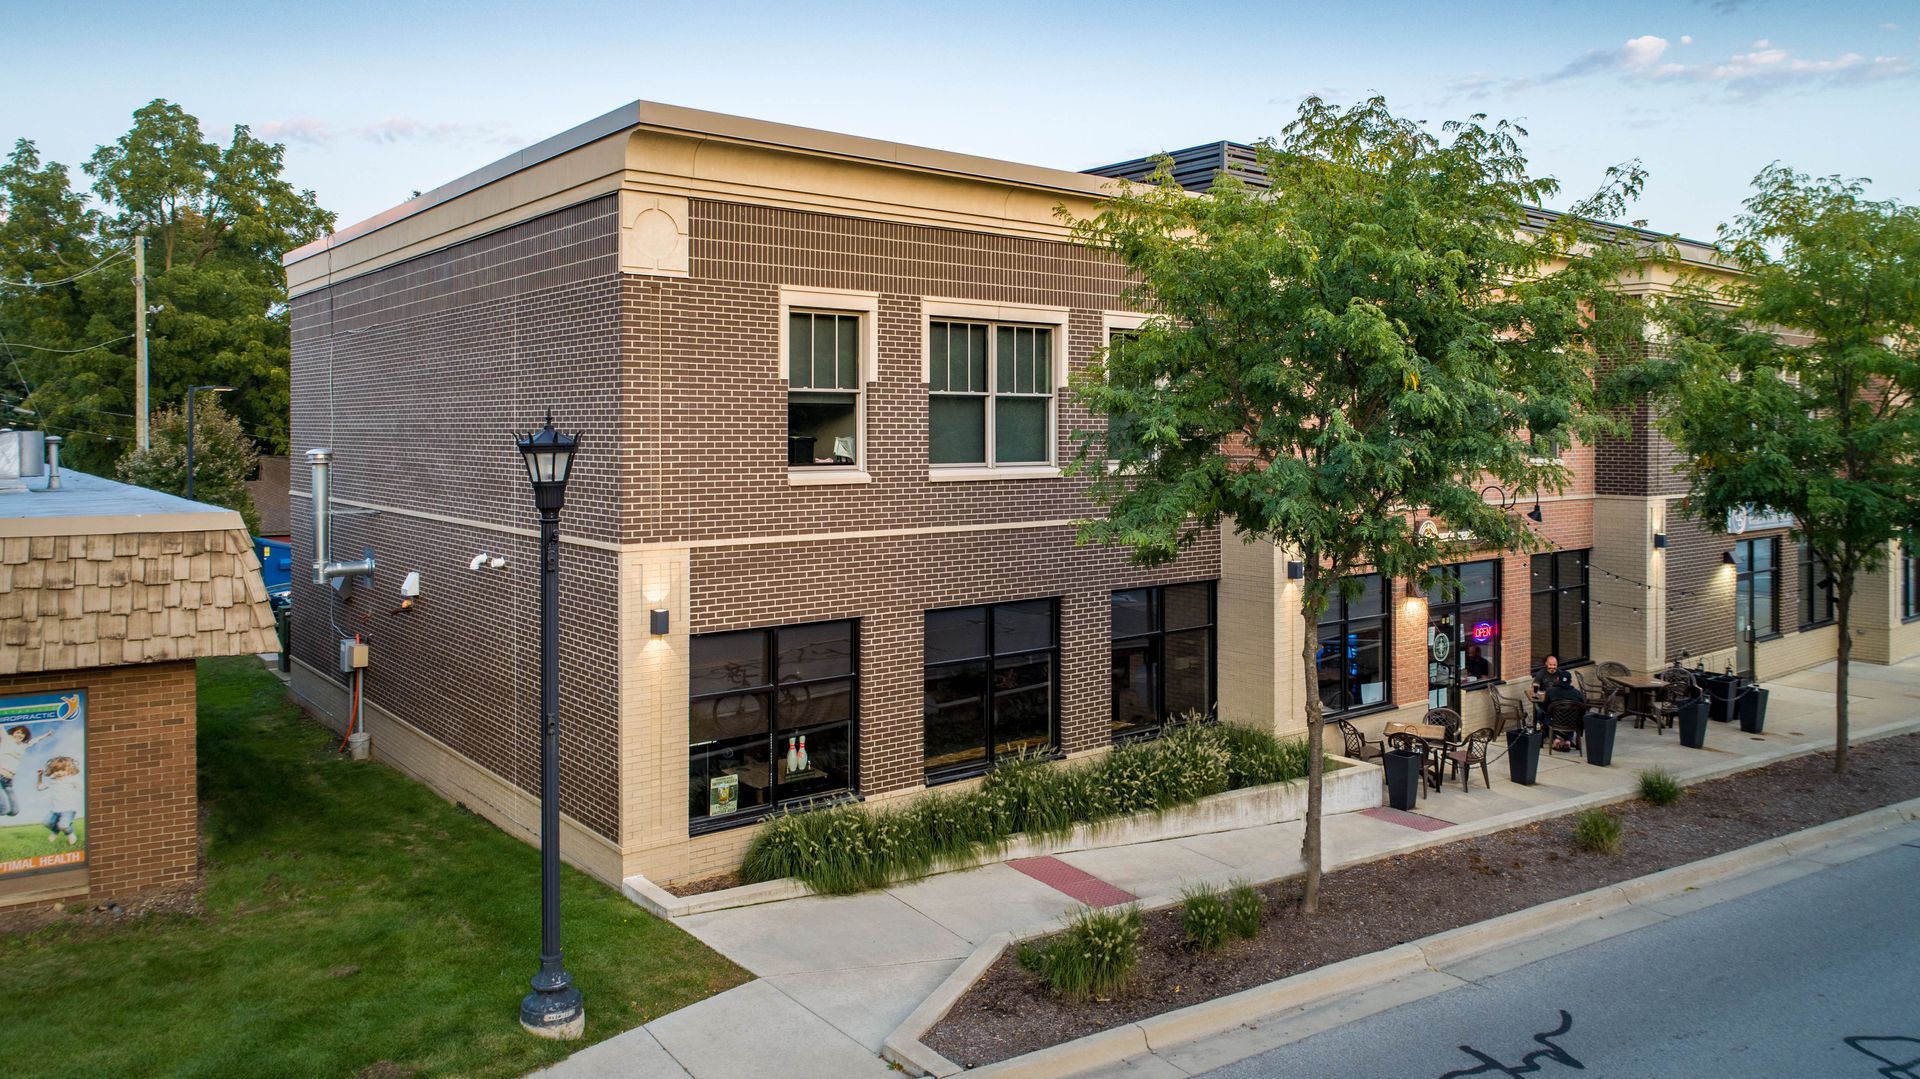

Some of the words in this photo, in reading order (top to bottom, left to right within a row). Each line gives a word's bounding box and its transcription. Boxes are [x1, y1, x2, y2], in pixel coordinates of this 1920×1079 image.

[1475, 626, 1492, 637] OPEN
[0, 711, 56, 722] IROPRACTIC
[40, 851, 80, 867] HEALTH
